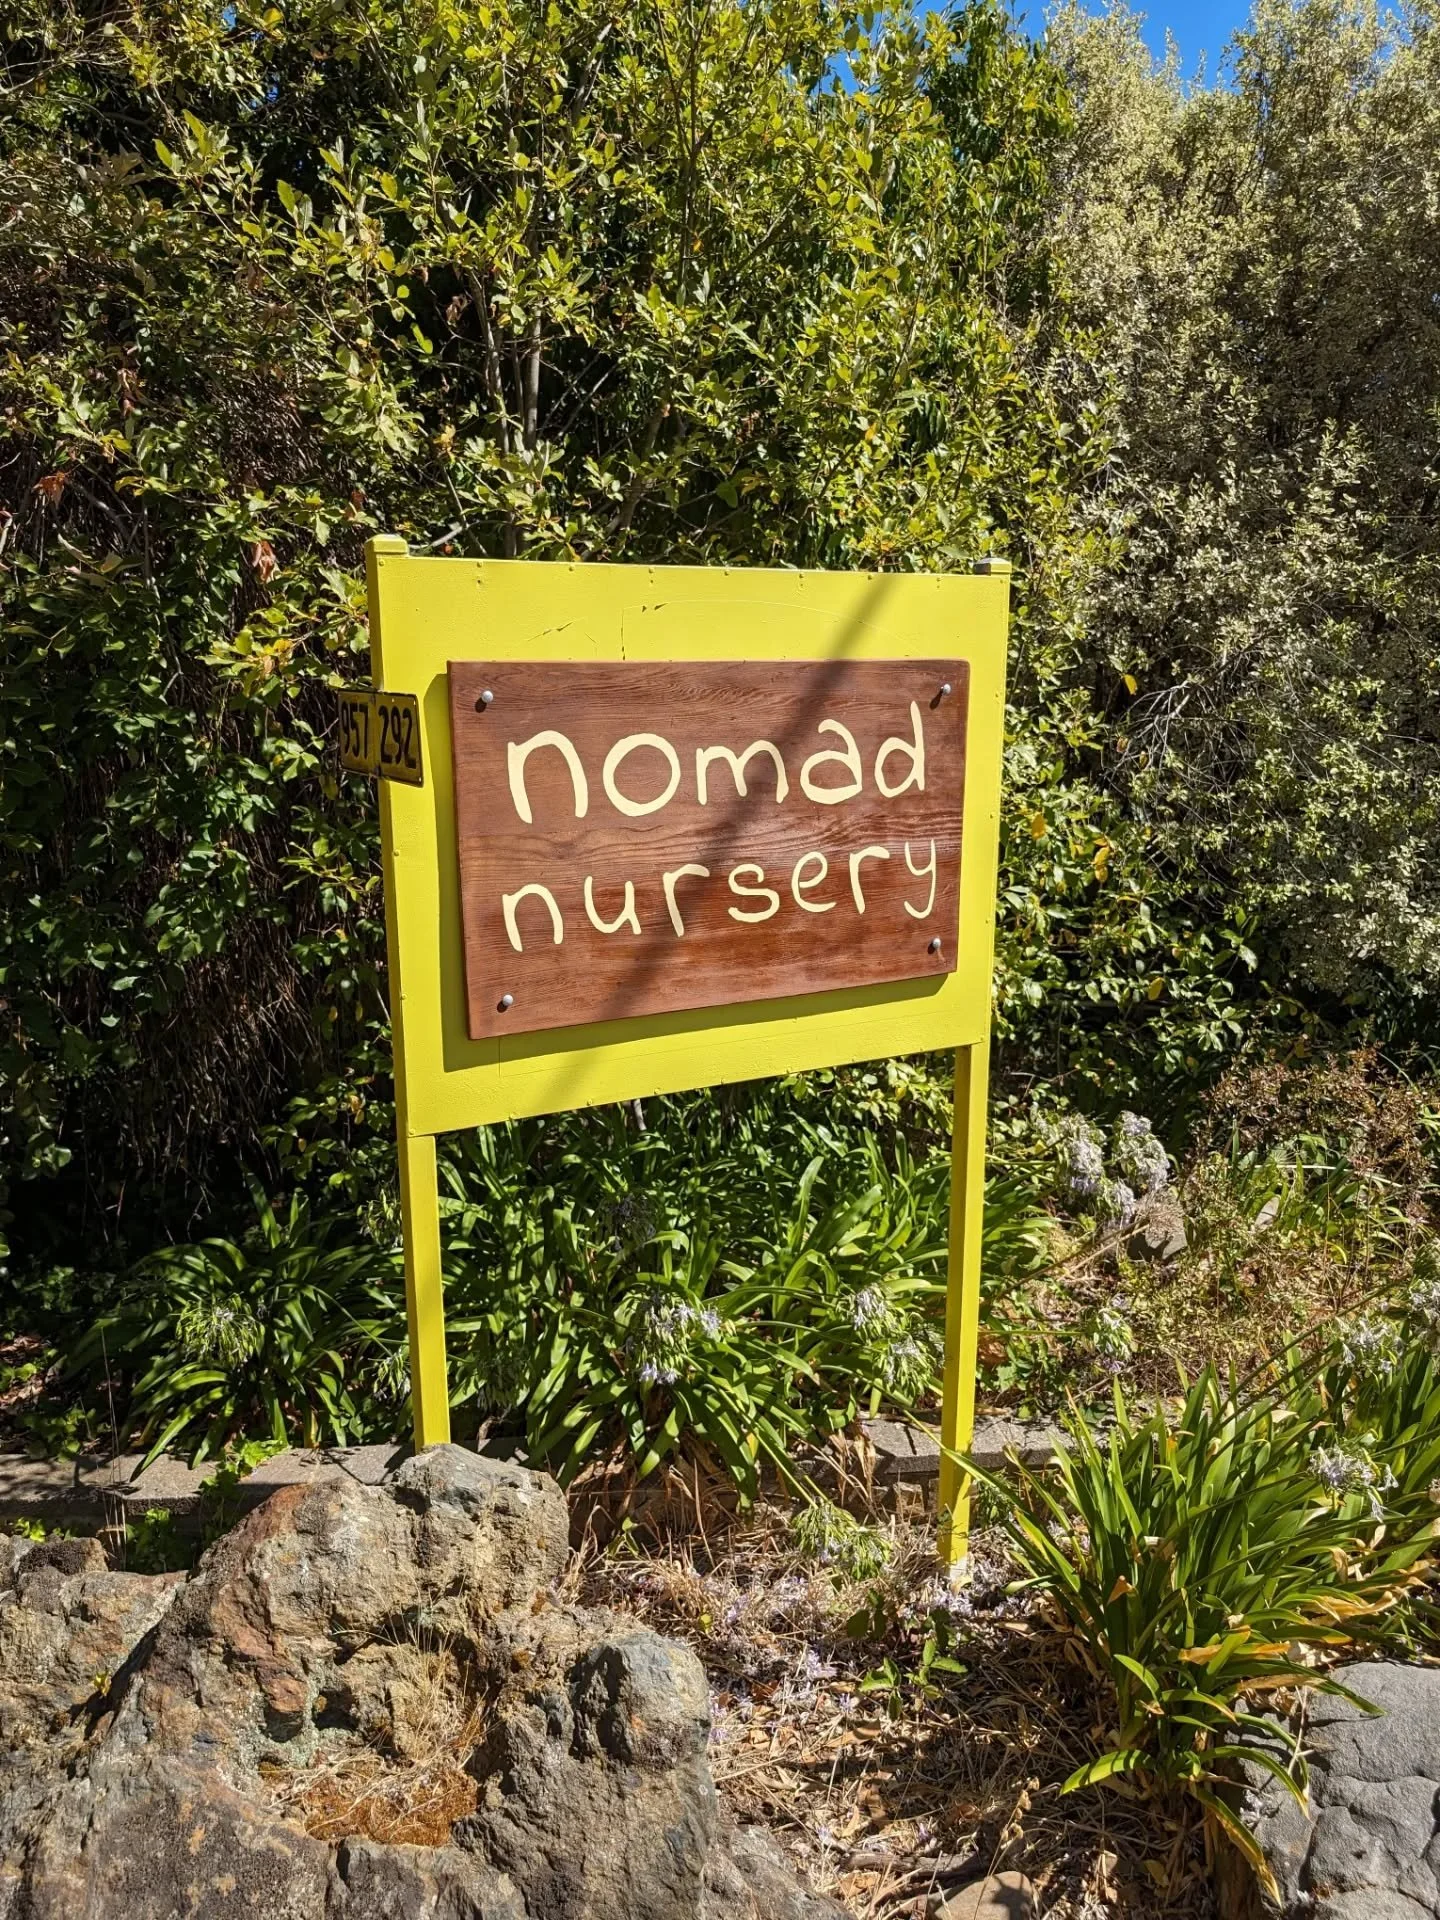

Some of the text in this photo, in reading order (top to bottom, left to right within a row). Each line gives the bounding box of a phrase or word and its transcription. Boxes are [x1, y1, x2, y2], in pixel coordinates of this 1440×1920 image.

[341, 701, 416, 769] 957 292
[507, 700, 924, 824] nomad
[502, 839, 936, 952] nursery
